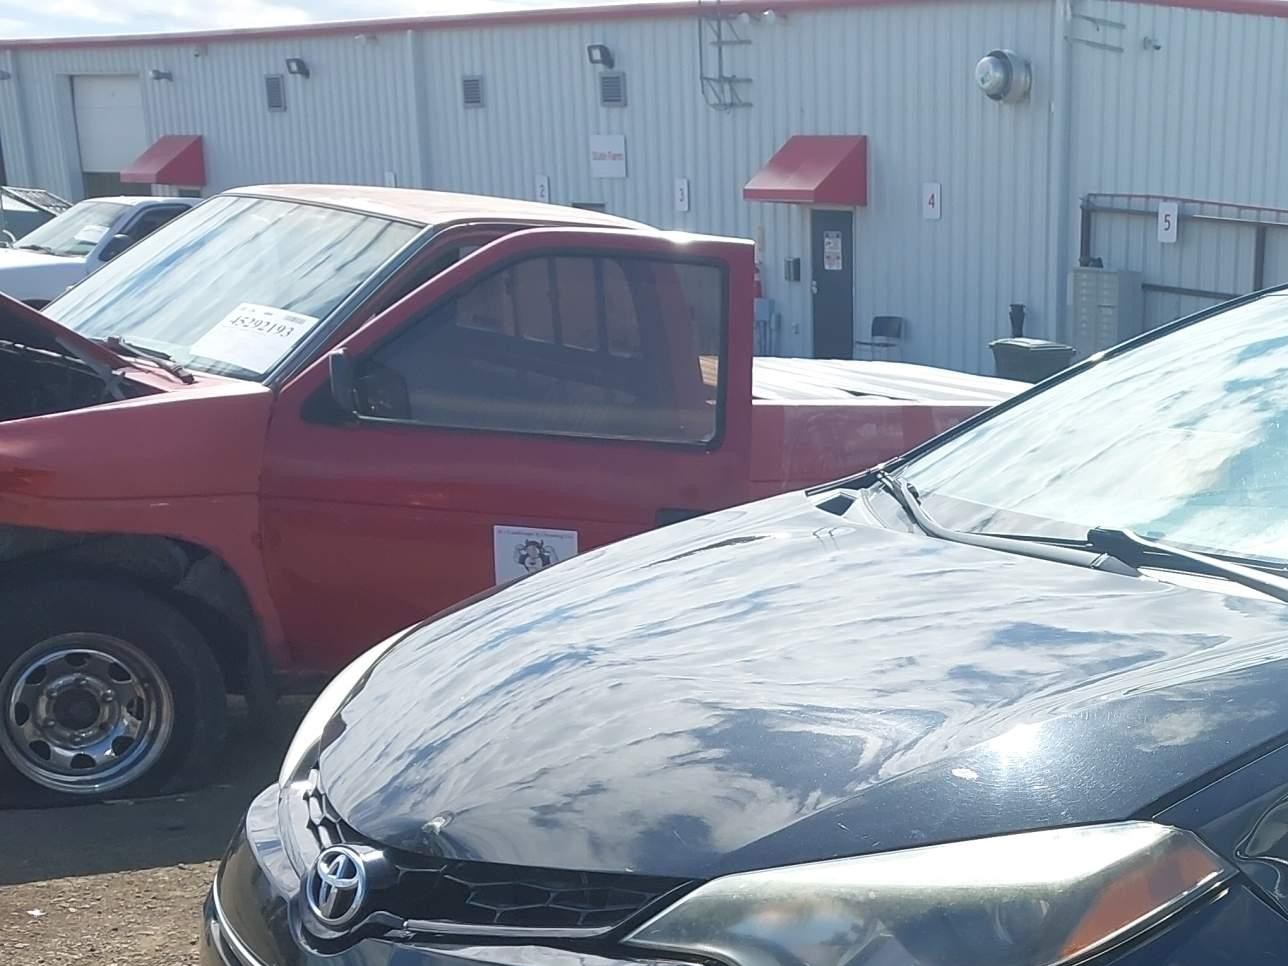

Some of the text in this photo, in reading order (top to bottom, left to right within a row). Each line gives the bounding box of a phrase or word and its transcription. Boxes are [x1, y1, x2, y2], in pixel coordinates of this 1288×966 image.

[928, 193, 935, 208] 4
[1163, 214, 1171, 231] 5
[230, 316, 295, 337] 45292193
